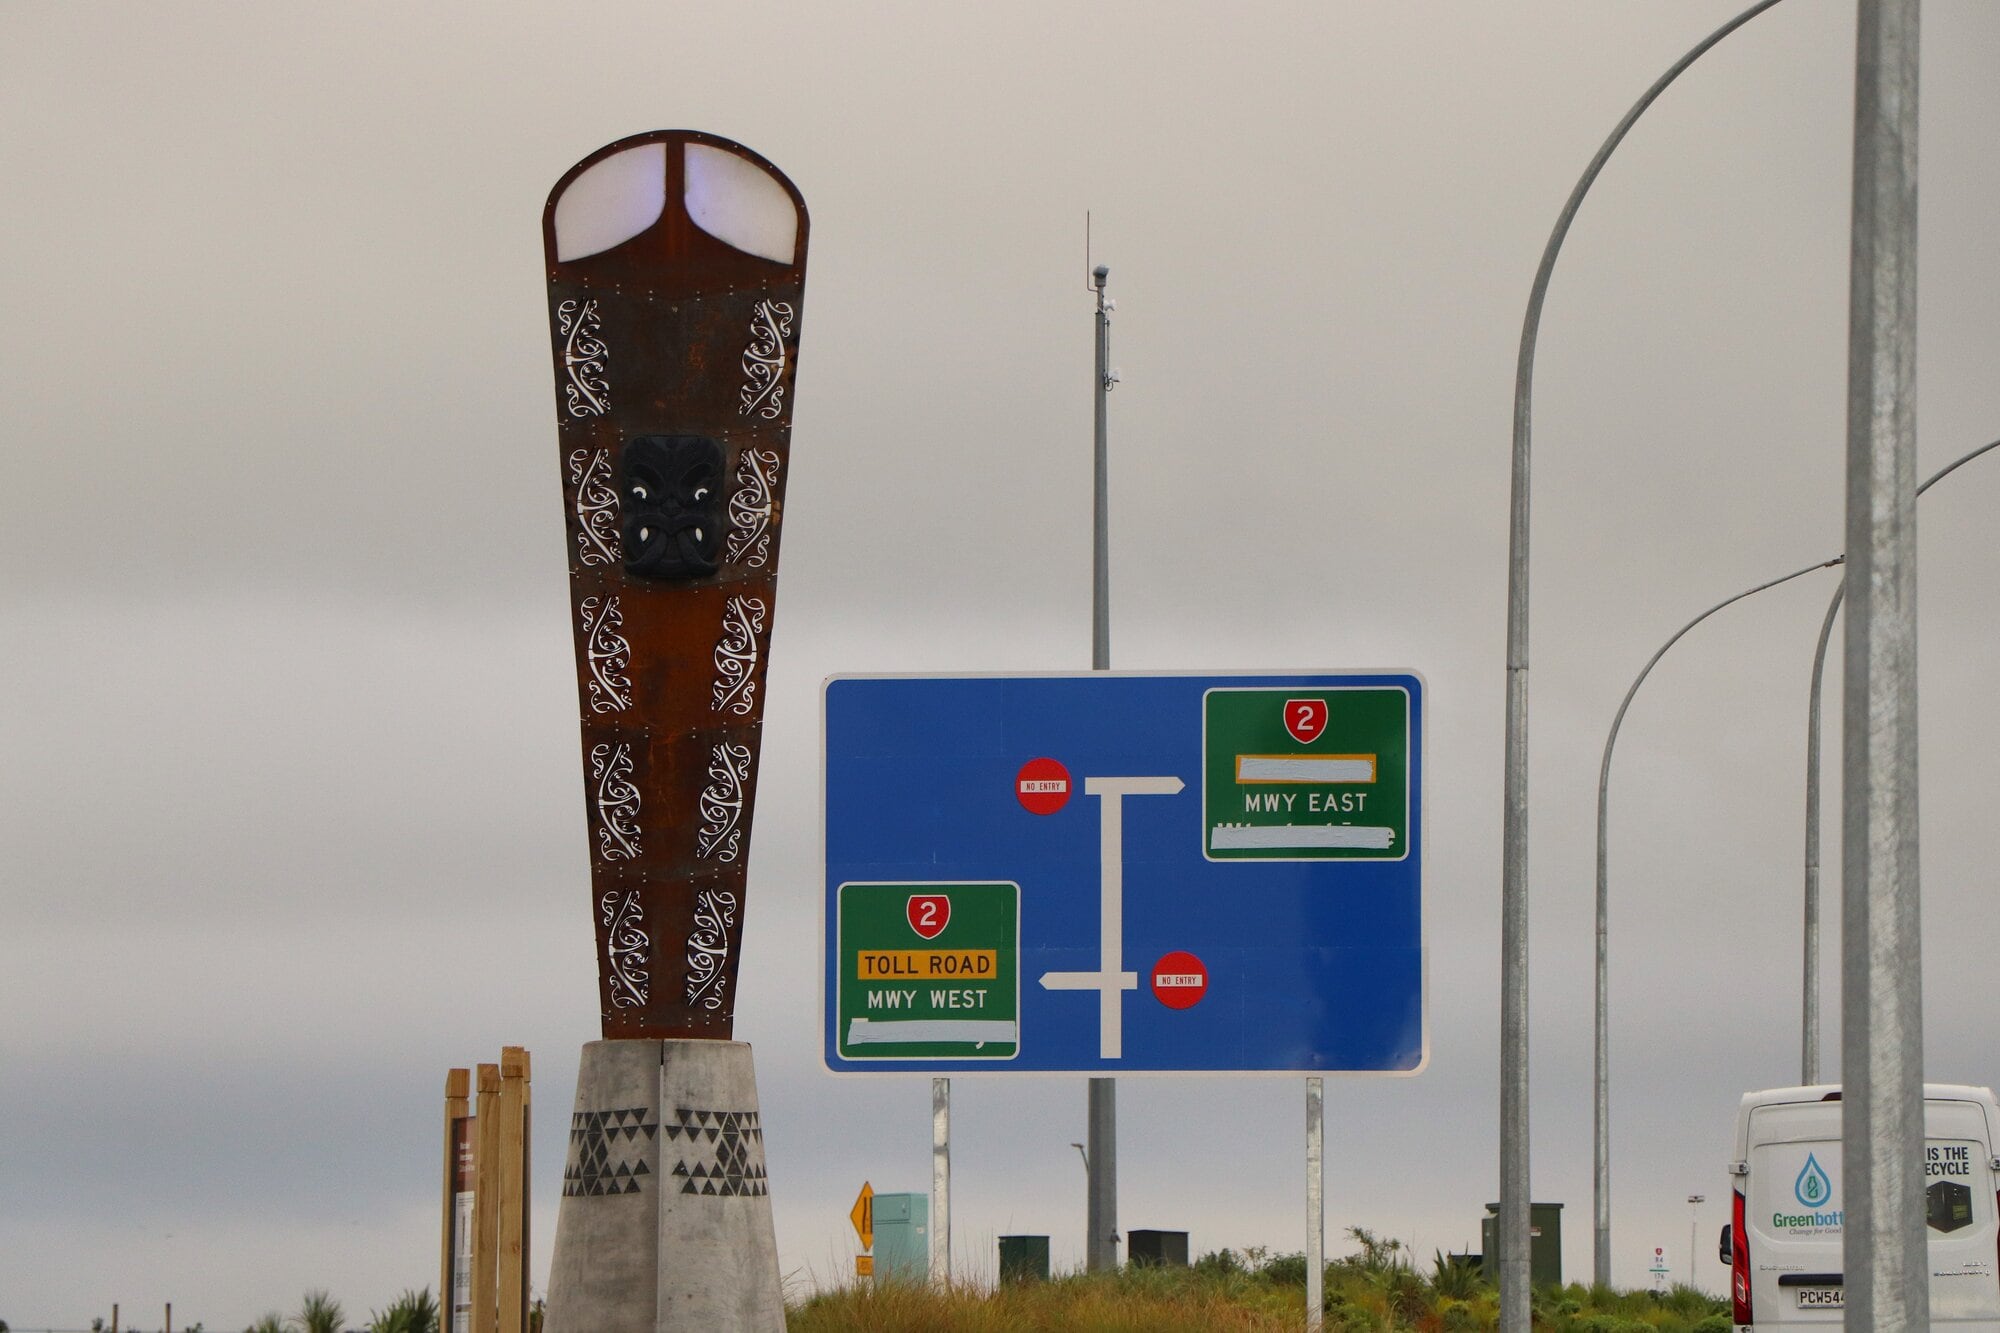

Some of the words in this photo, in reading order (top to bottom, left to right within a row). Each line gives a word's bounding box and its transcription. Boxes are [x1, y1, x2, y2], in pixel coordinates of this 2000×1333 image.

[1297, 705, 1314, 731] 2
[1026, 782, 1036, 791] NO
[1039, 782, 1060, 791] ENTRY
[1245, 793, 1297, 813] MWY
[1308, 793, 1367, 812] EAST
[920, 901, 937, 926] 2
[864, 955, 919, 975] TOLL
[929, 955, 990, 974] ROAD
[1162, 976, 1171, 985] NO
[1175, 976, 1197, 985] ENTRY
[868, 990, 918, 1009] MWY
[930, 989, 988, 1009] WEST
[1926, 1147, 1940, 1161] IS
[1943, 1146, 1969, 1160] THE
[1789, 1228, 1812, 1236] Change
[1814, 1228, 1824, 1236] for
